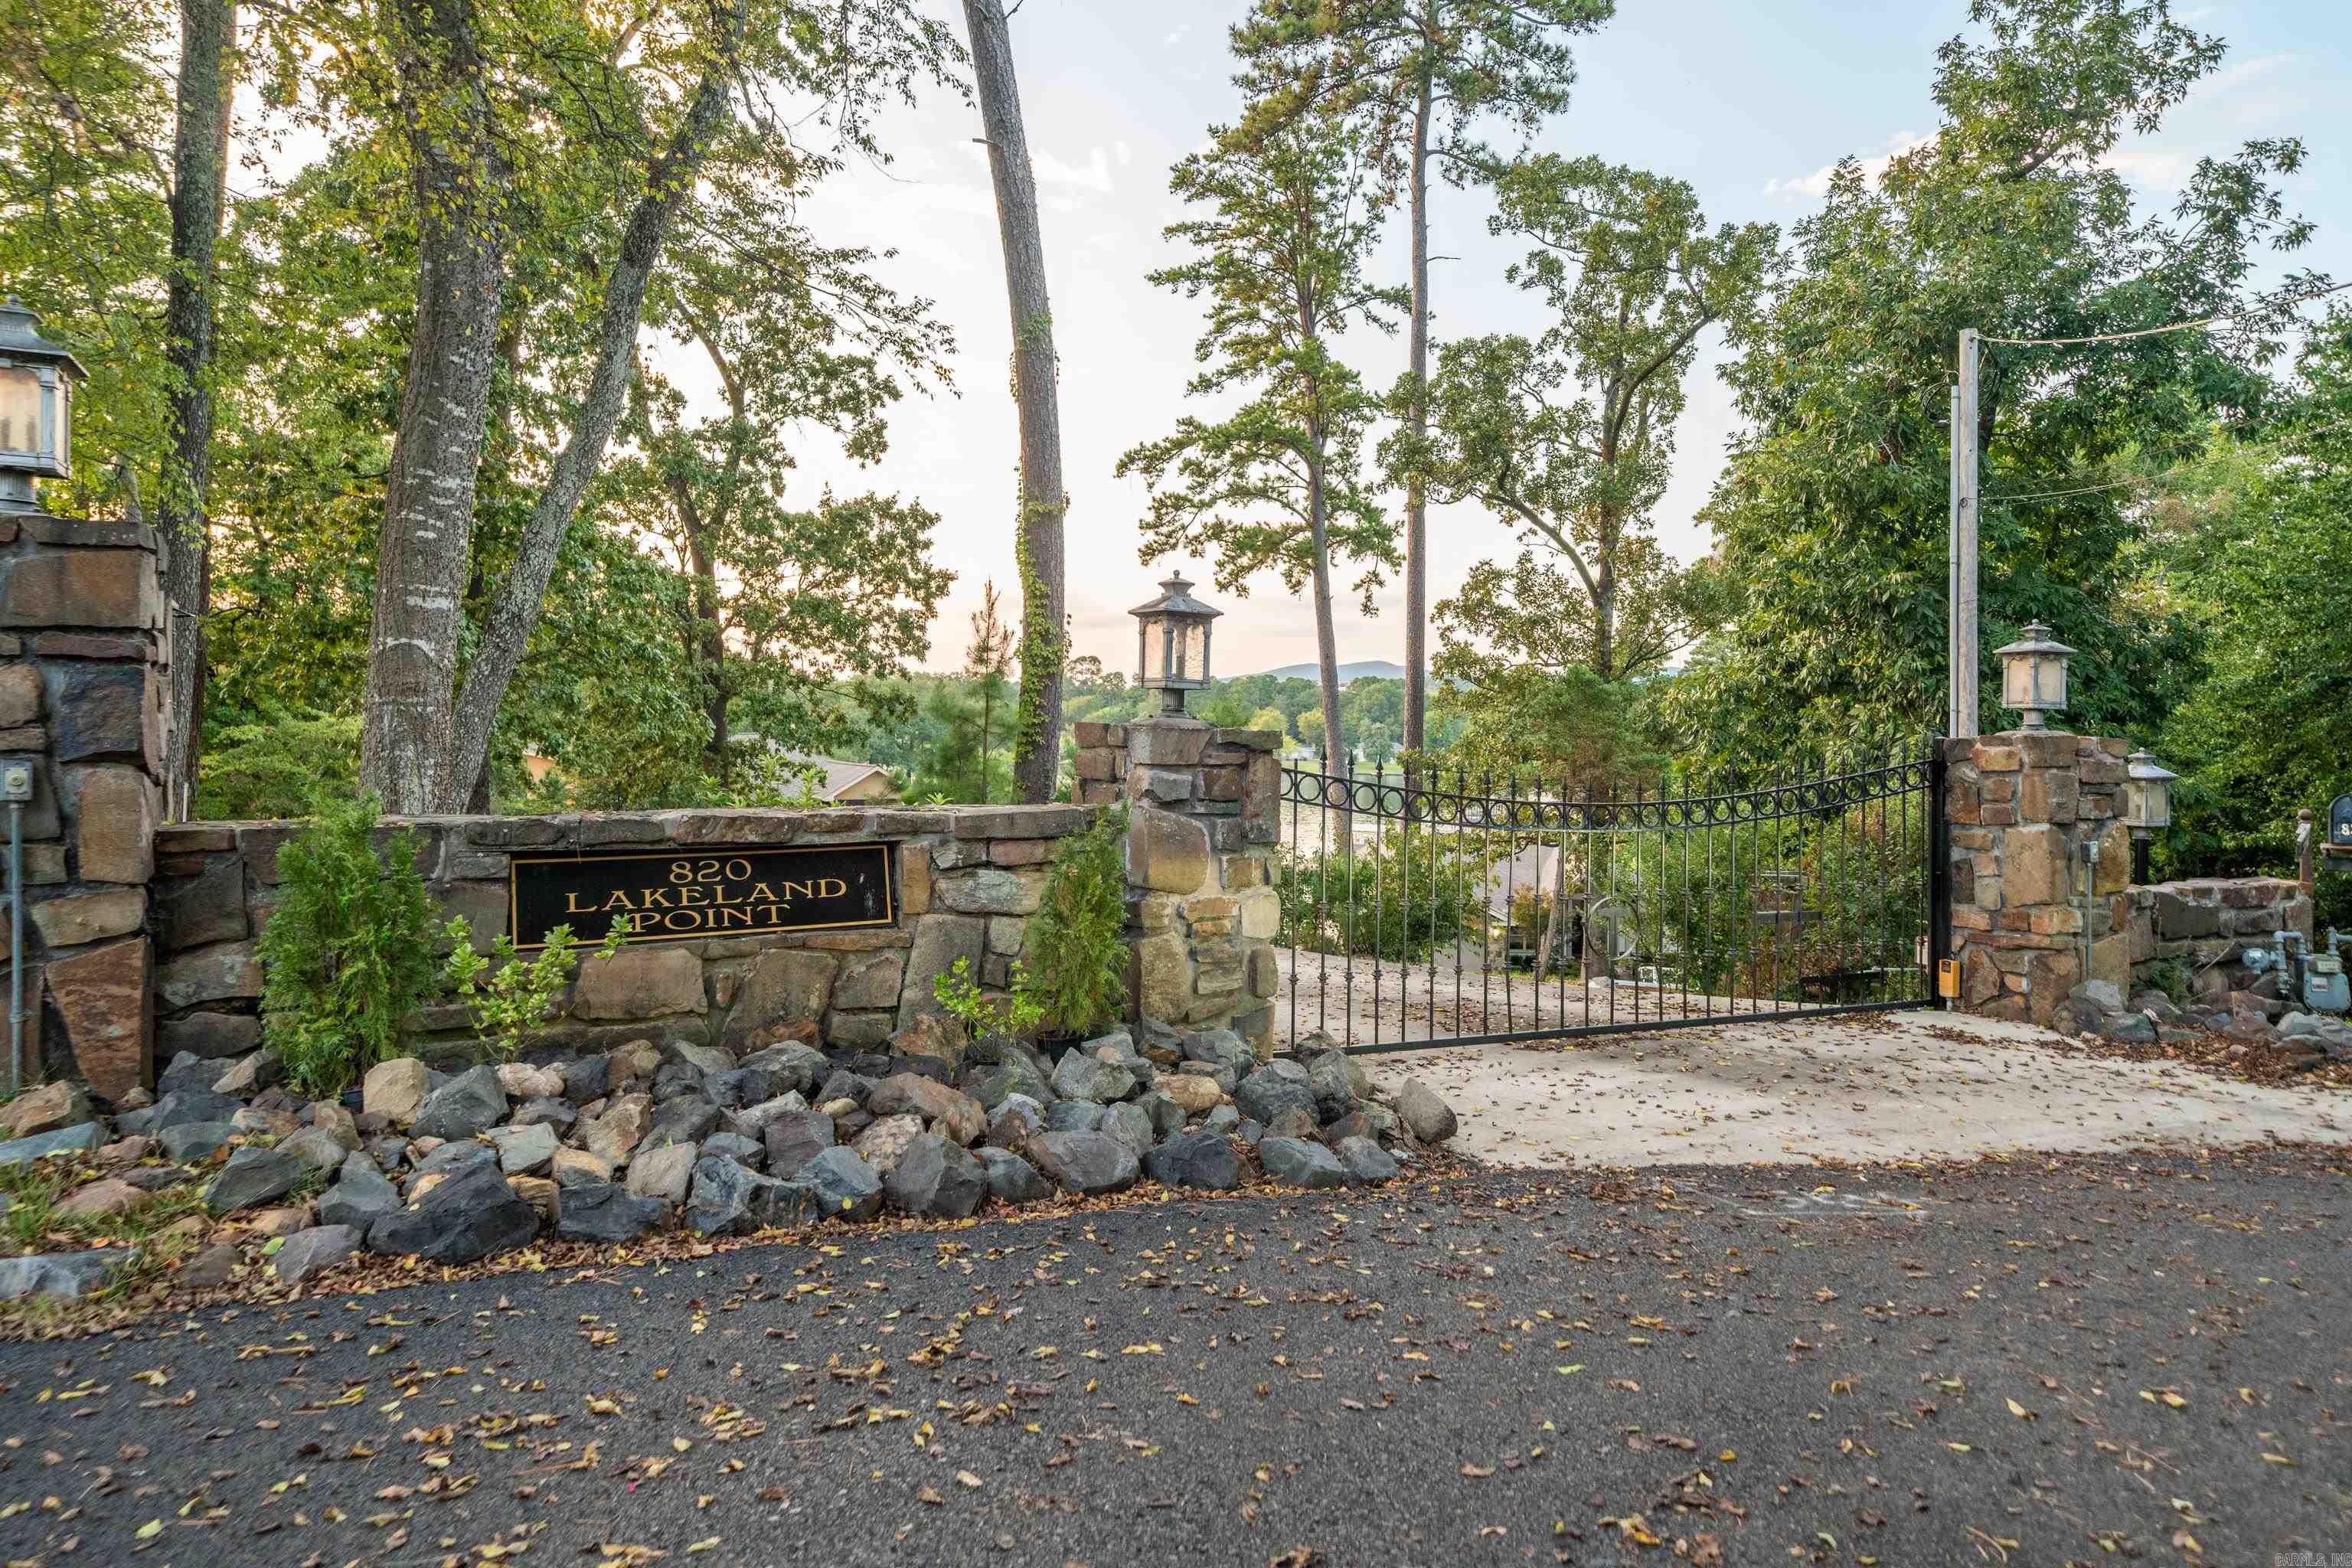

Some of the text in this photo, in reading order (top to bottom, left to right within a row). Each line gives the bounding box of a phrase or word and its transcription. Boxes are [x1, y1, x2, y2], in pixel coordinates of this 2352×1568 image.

[2341, 823, 2352, 836] 8
[669, 859, 752, 884] 820
[565, 879, 847, 913] LAKELAND
[629, 903, 791, 932] POINT
